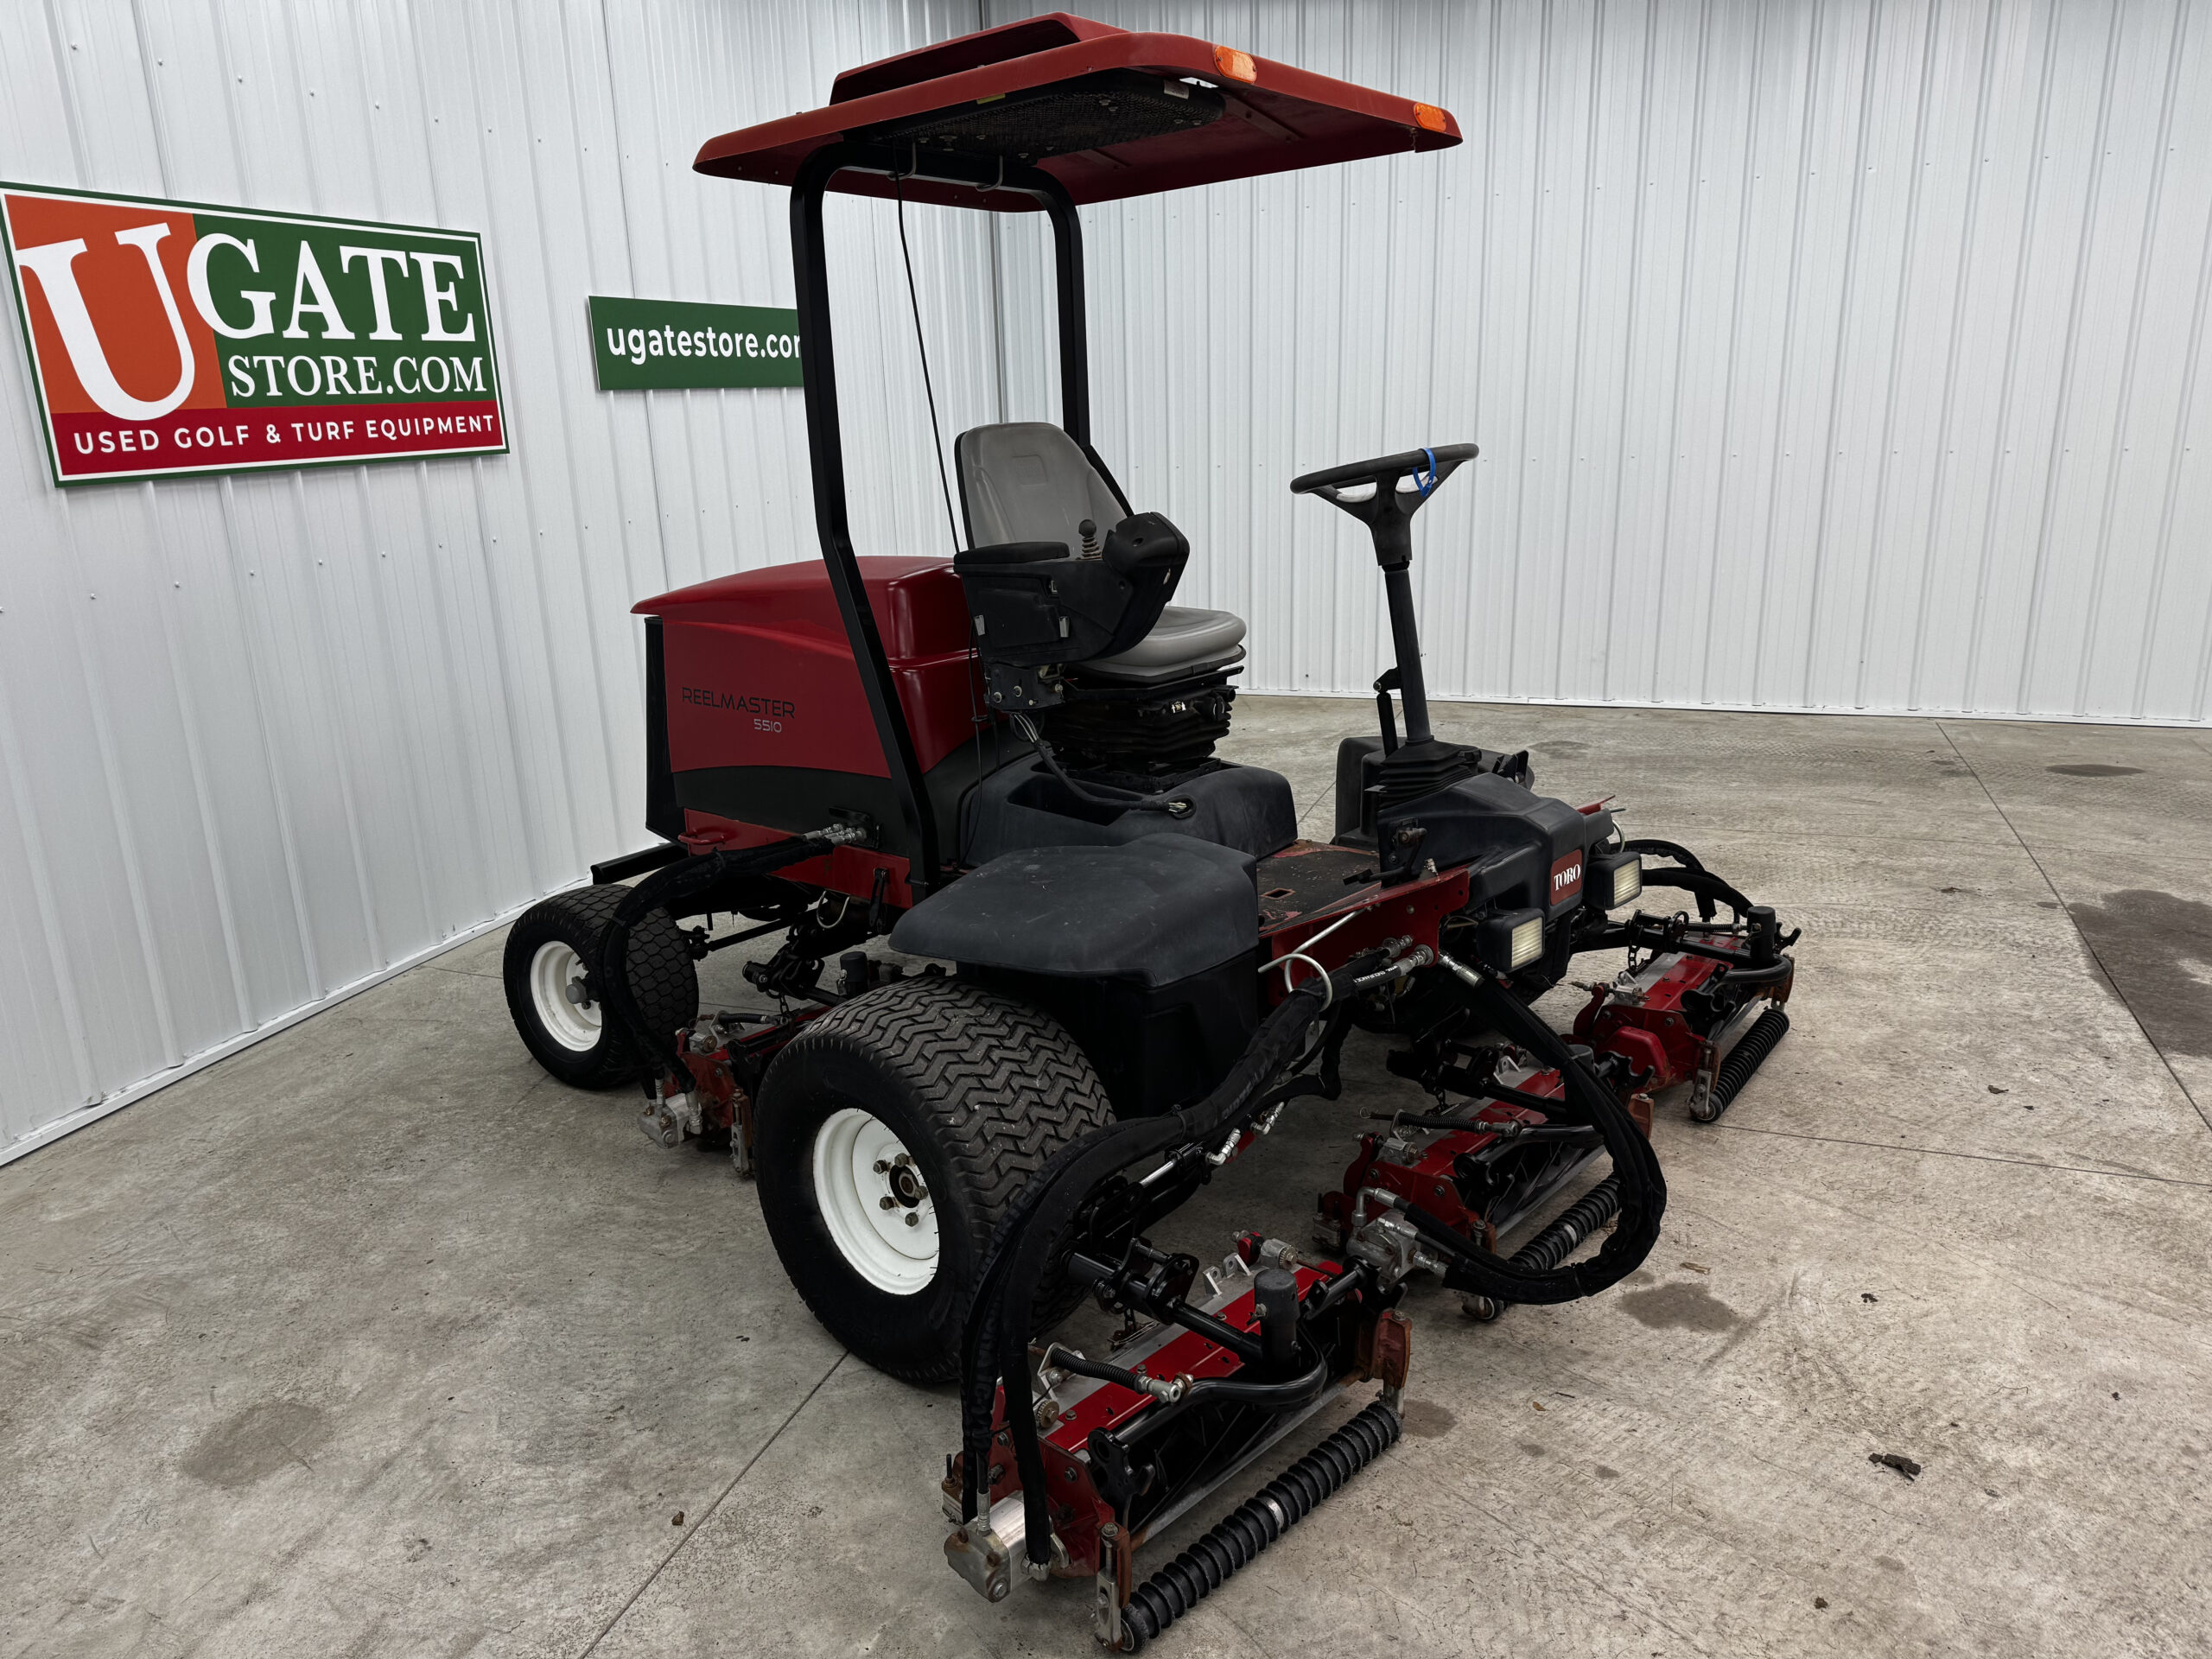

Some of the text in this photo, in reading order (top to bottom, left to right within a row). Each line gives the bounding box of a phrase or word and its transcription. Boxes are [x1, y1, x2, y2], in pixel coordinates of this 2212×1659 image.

[228, 354, 487, 397] STORE.COM
[74, 415, 493, 454] USED GOLF & TURF EQUIPMENT
[682, 687, 795, 719] REELMASTER
[753, 719, 782, 733] 5510
[1554, 864, 1581, 891] TORO
